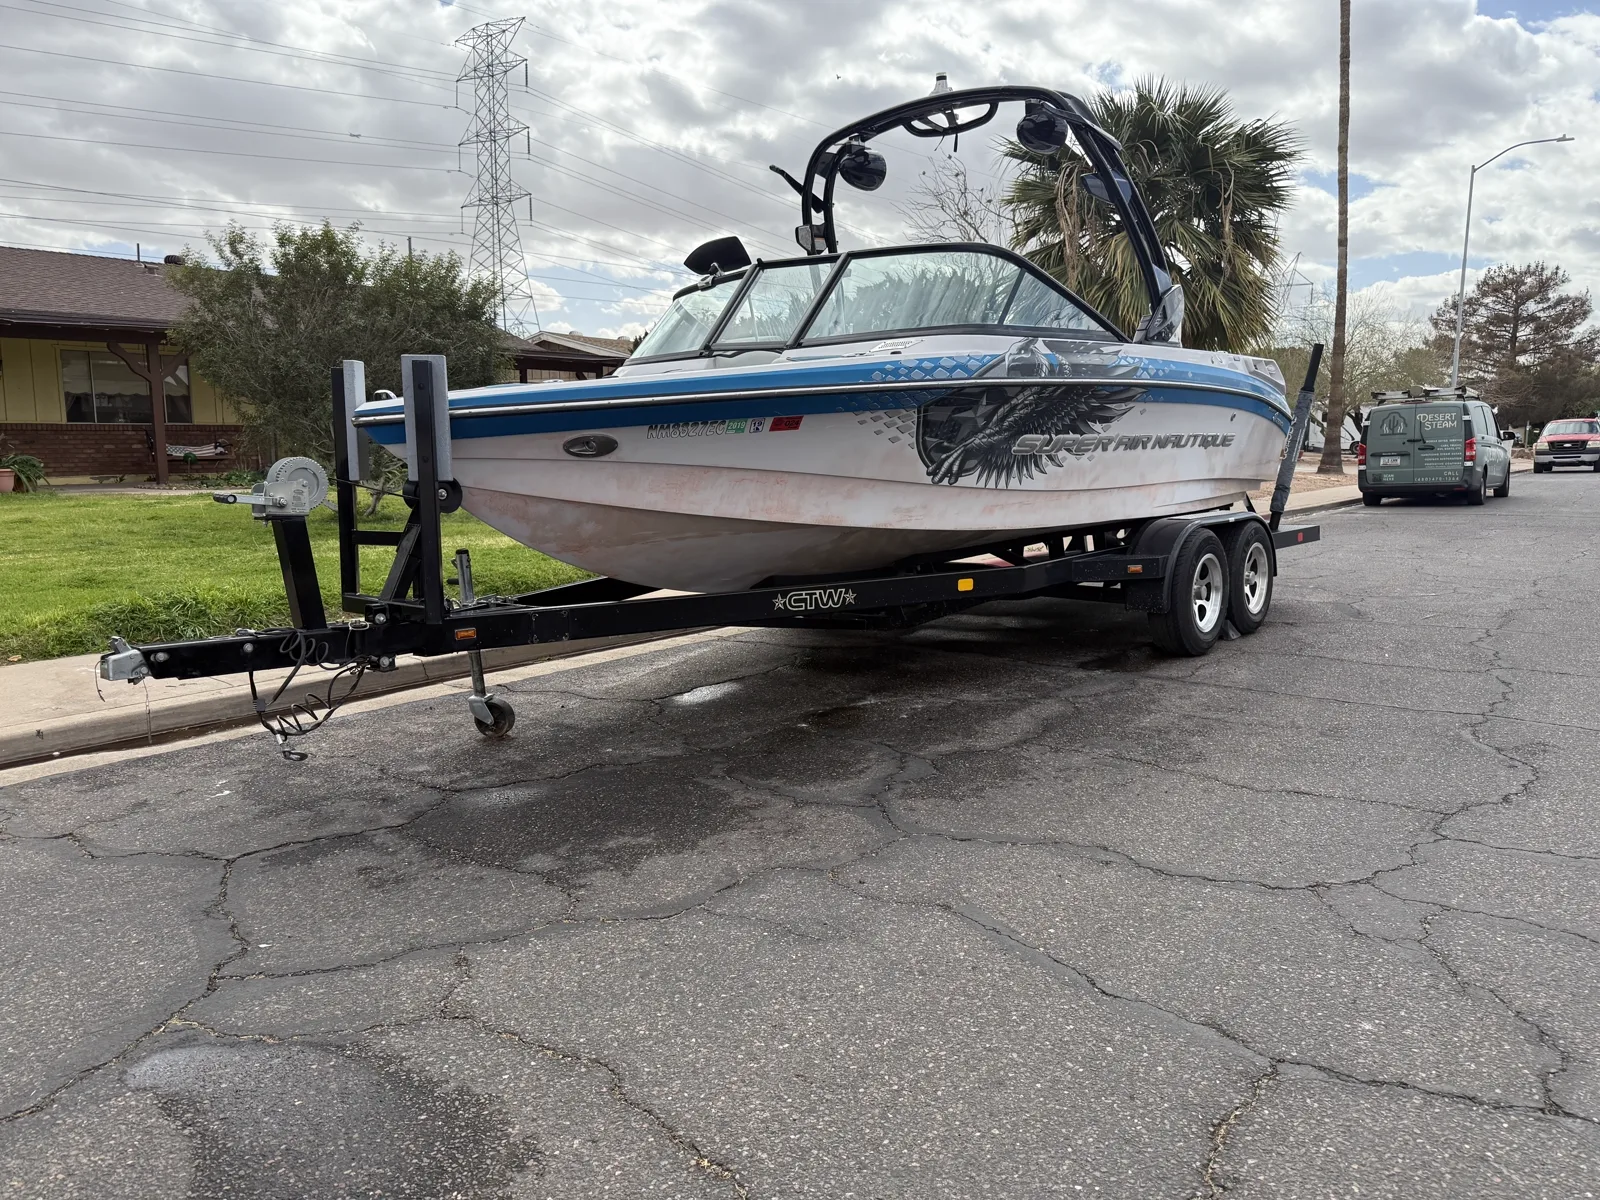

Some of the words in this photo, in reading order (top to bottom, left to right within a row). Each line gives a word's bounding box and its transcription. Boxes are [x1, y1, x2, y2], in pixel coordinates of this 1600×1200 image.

[1417, 413, 1457, 423] DESERT
[728, 422, 746, 430] 2019
[1425, 421, 1457, 430] STEAM
[1012, 434, 1114, 455] SUPER
[1113, 434, 1151, 452] AIR
[1151, 432, 1236, 450] NAUTIQUE
[786, 588, 845, 610] CTW
